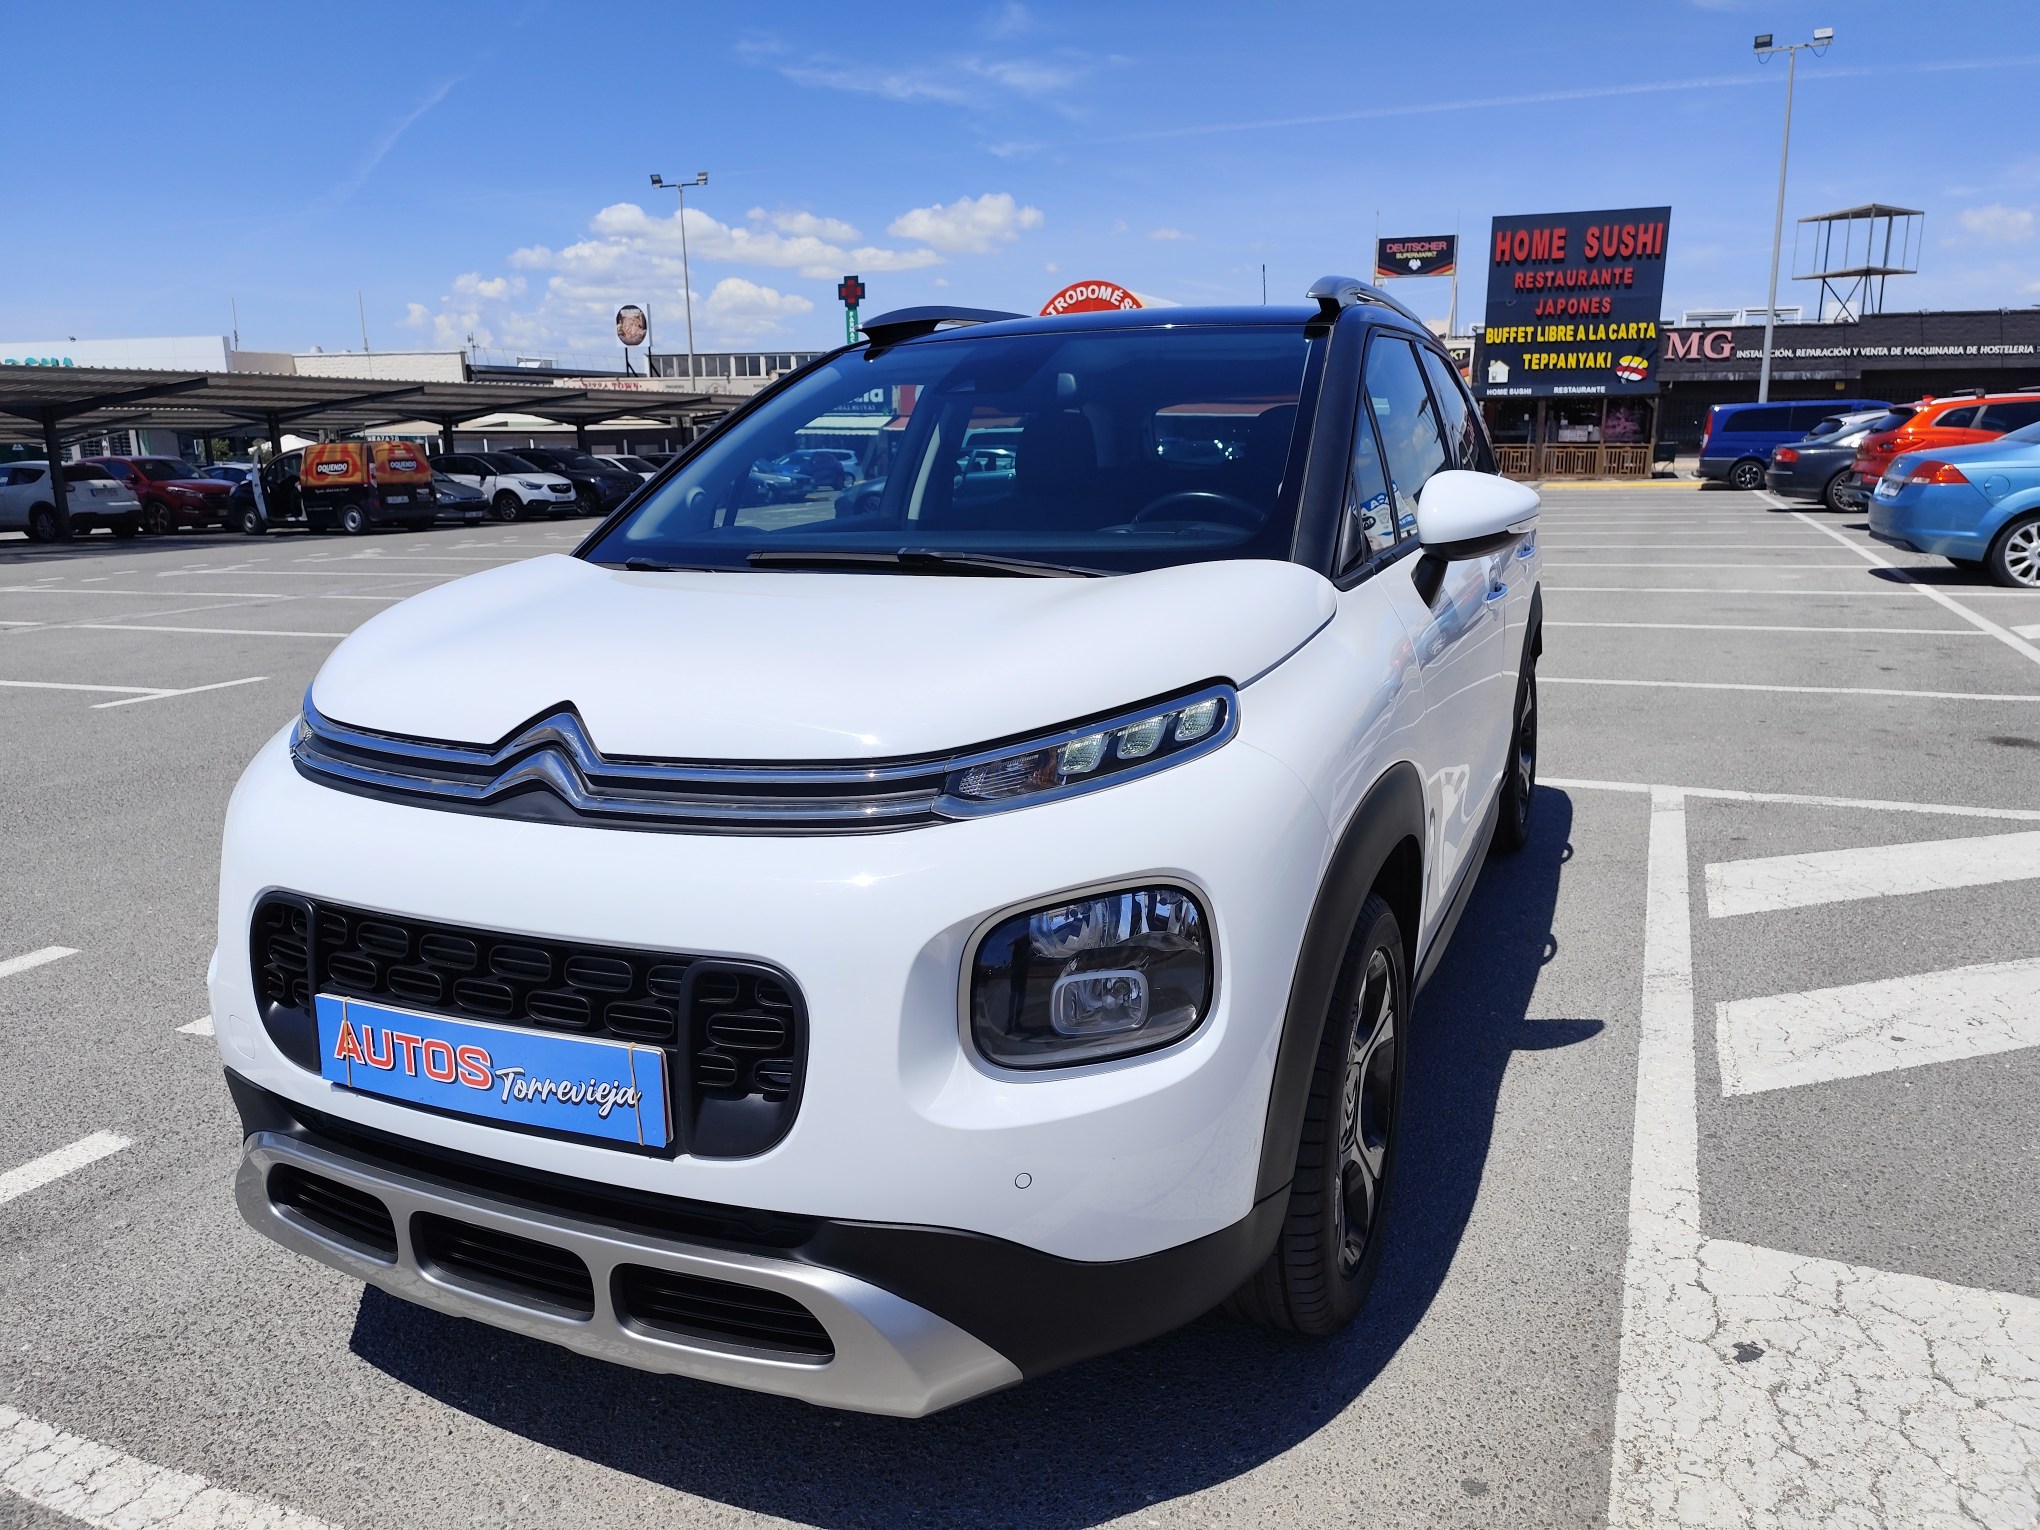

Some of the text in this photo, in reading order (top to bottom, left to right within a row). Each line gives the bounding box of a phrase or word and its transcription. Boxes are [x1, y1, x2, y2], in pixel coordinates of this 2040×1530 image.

[1386, 241, 1447, 253] DEUTSCHER
[1494, 222, 1664, 263] HOME SUSHI
[1395, 250, 1438, 260] SUPERMARKT
[1513, 267, 1634, 289] RESTAURANTE
[1534, 297, 1612, 317] JAPONES
[1485, 322, 1656, 344] BUFFET LIBRE A LA CARTA
[1664, 330, 1735, 360] MG
[1736, 347, 1795, 359] INSTALCIÓN,
[1796, 345, 1850, 358] REPARACIÓN
[1852, 347, 1861, 357] Y
[1860, 346, 1888, 357] VENTA
[1890, 346, 1901, 357] DE
[1904, 345, 1964, 357] MAQUINARIA
[1966, 345, 1978, 355] DE
[1522, 352, 1612, 370] TEPPANYAKI
[1486, 385, 1606, 396] HOME SUSHI RESTAURANTE
[317, 463, 347, 473] OQUENDO
[390, 460, 417, 470] OQUENDO
[333, 1019, 642, 1119] AUTOS Torrevieja
